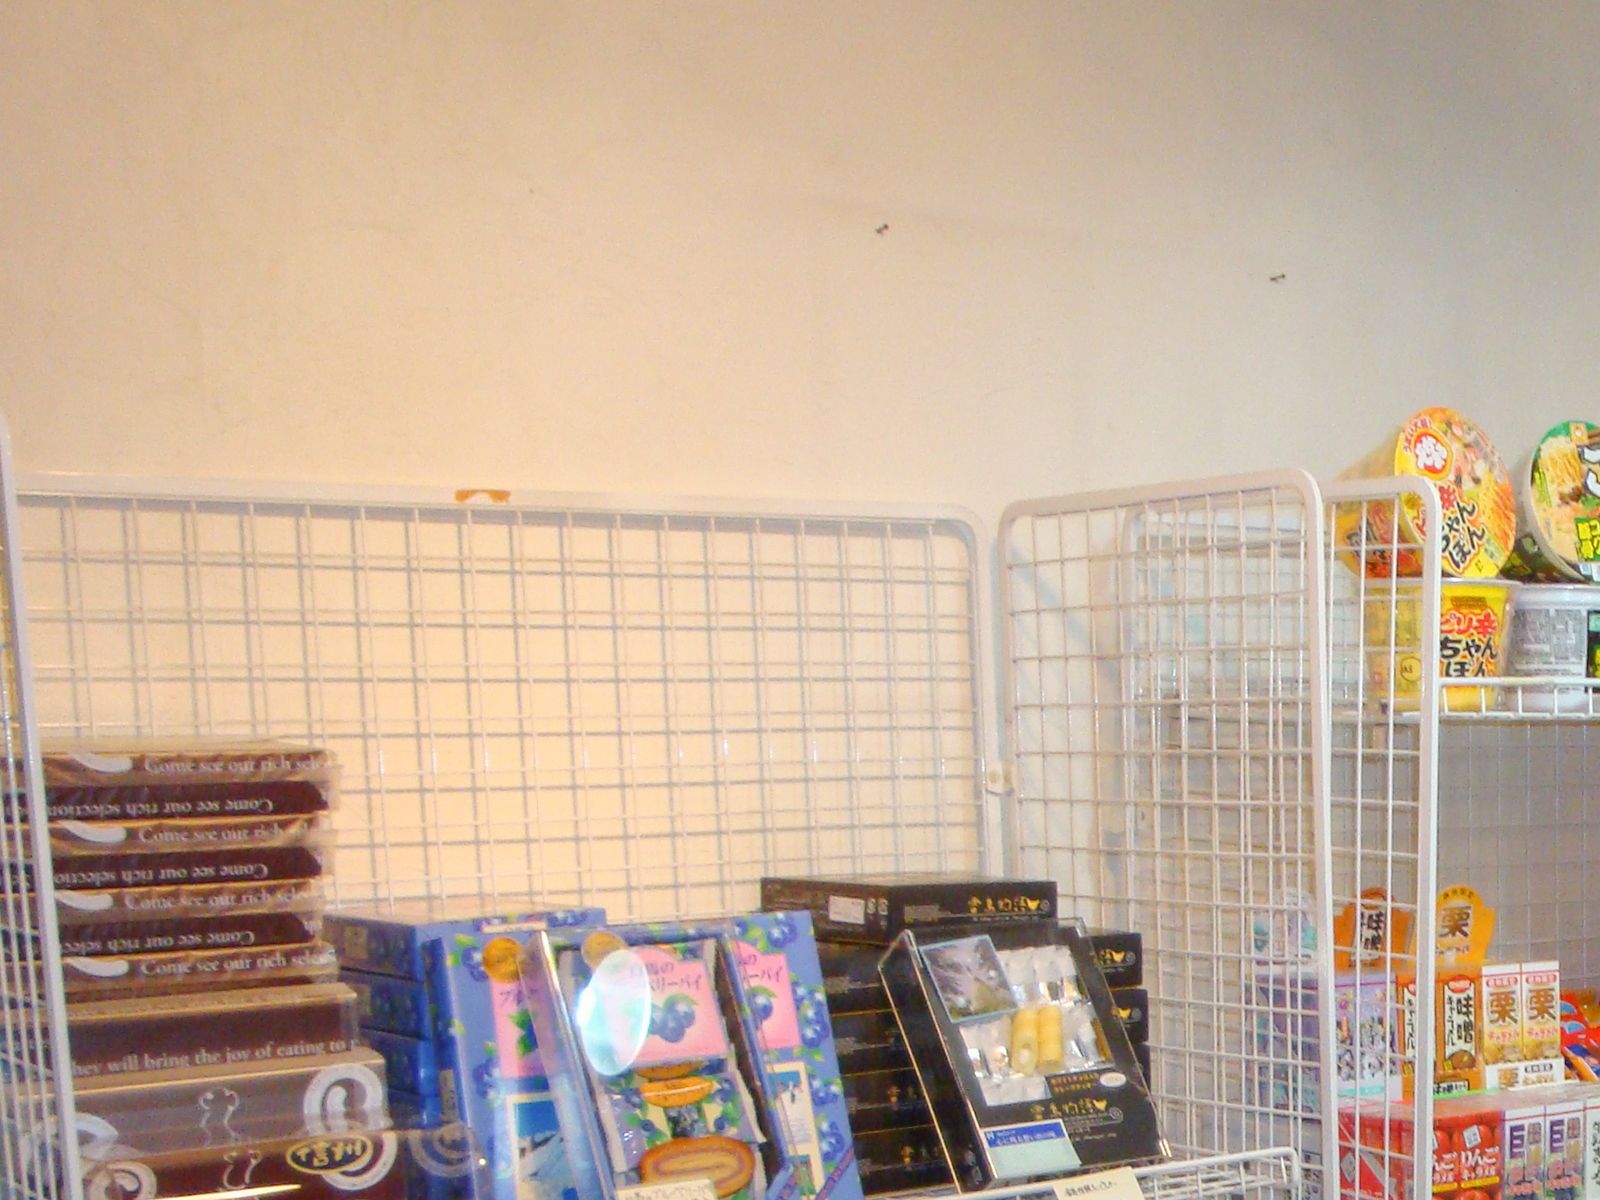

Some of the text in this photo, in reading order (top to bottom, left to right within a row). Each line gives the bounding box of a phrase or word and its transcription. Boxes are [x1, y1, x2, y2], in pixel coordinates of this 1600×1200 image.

[163, 801, 193, 813] our
[225, 798, 274, 813] Come
[53, 863, 269, 888] Come see our rich selectio
[143, 934, 175, 950] our
[178, 932, 203, 946] see
[207, 930, 255, 946] Come
[141, 952, 288, 976] Come see our rich
[1488, 989, 1519, 1025] 栗
[1528, 986, 1557, 1022] 栗
[71, 1059, 101, 1077] hey
[107, 1055, 139, 1073] will
[143, 1051, 191, 1071] bring
[194, 1046, 221, 1065] the
[224, 1047, 250, 1065] joy
[255, 1040, 275, 1059] of
[276, 1040, 326, 1059] eating
